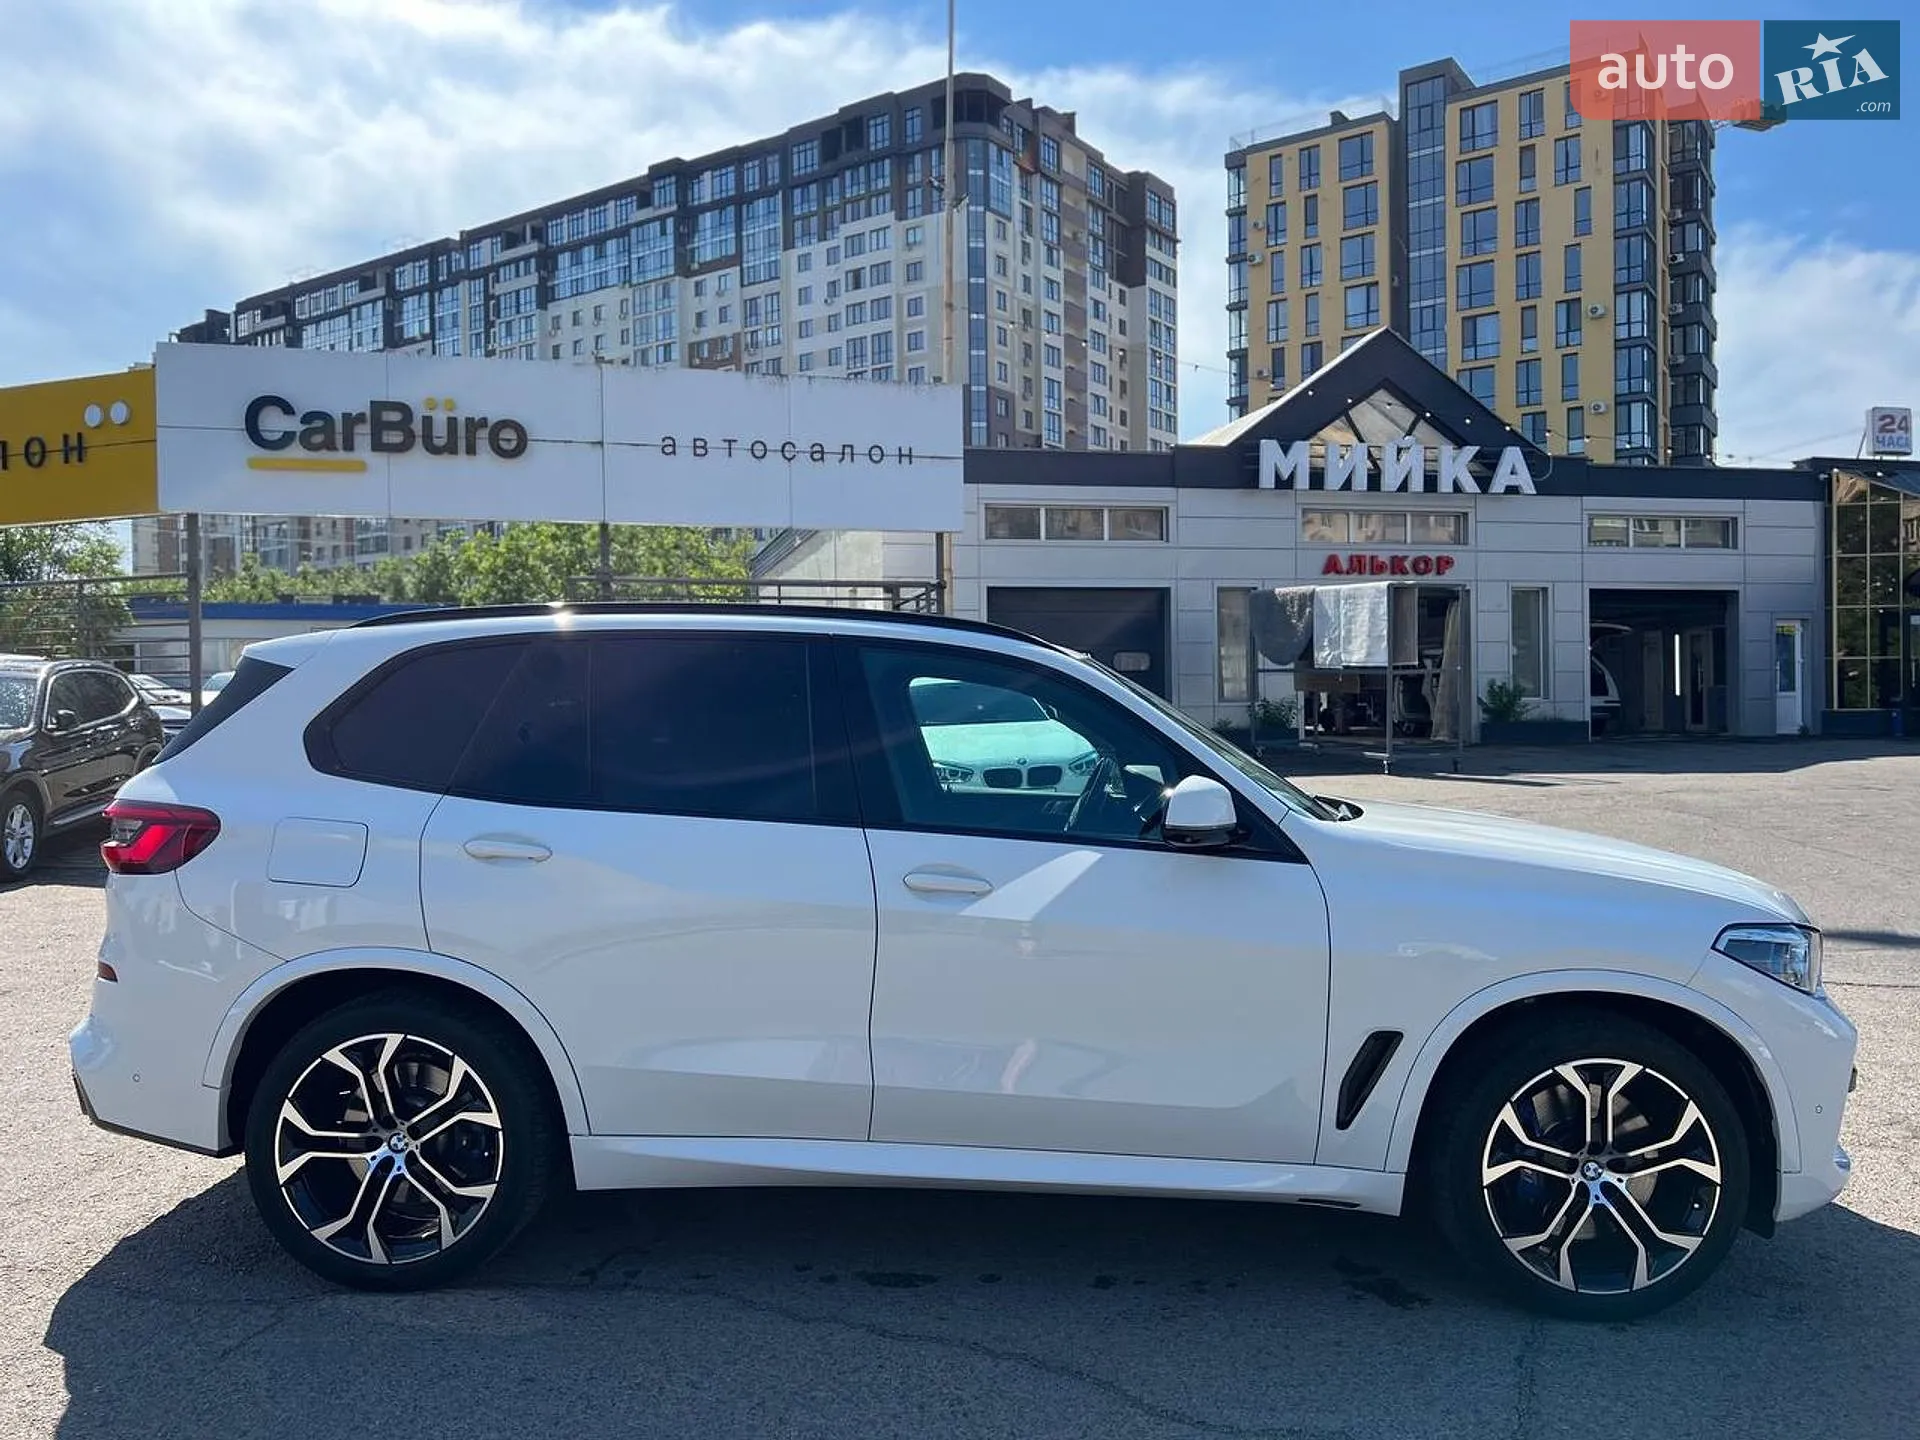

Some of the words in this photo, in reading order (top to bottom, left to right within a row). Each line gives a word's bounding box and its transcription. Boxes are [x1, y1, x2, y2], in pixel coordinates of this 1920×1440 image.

[244, 394, 528, 459] CarBüro
[1878, 414, 1908, 434] 24
[660, 435, 913, 465] автосалон
[1258, 435, 1537, 495] МИЙКА
[1322, 553, 1455, 577] АЛЬКОР
